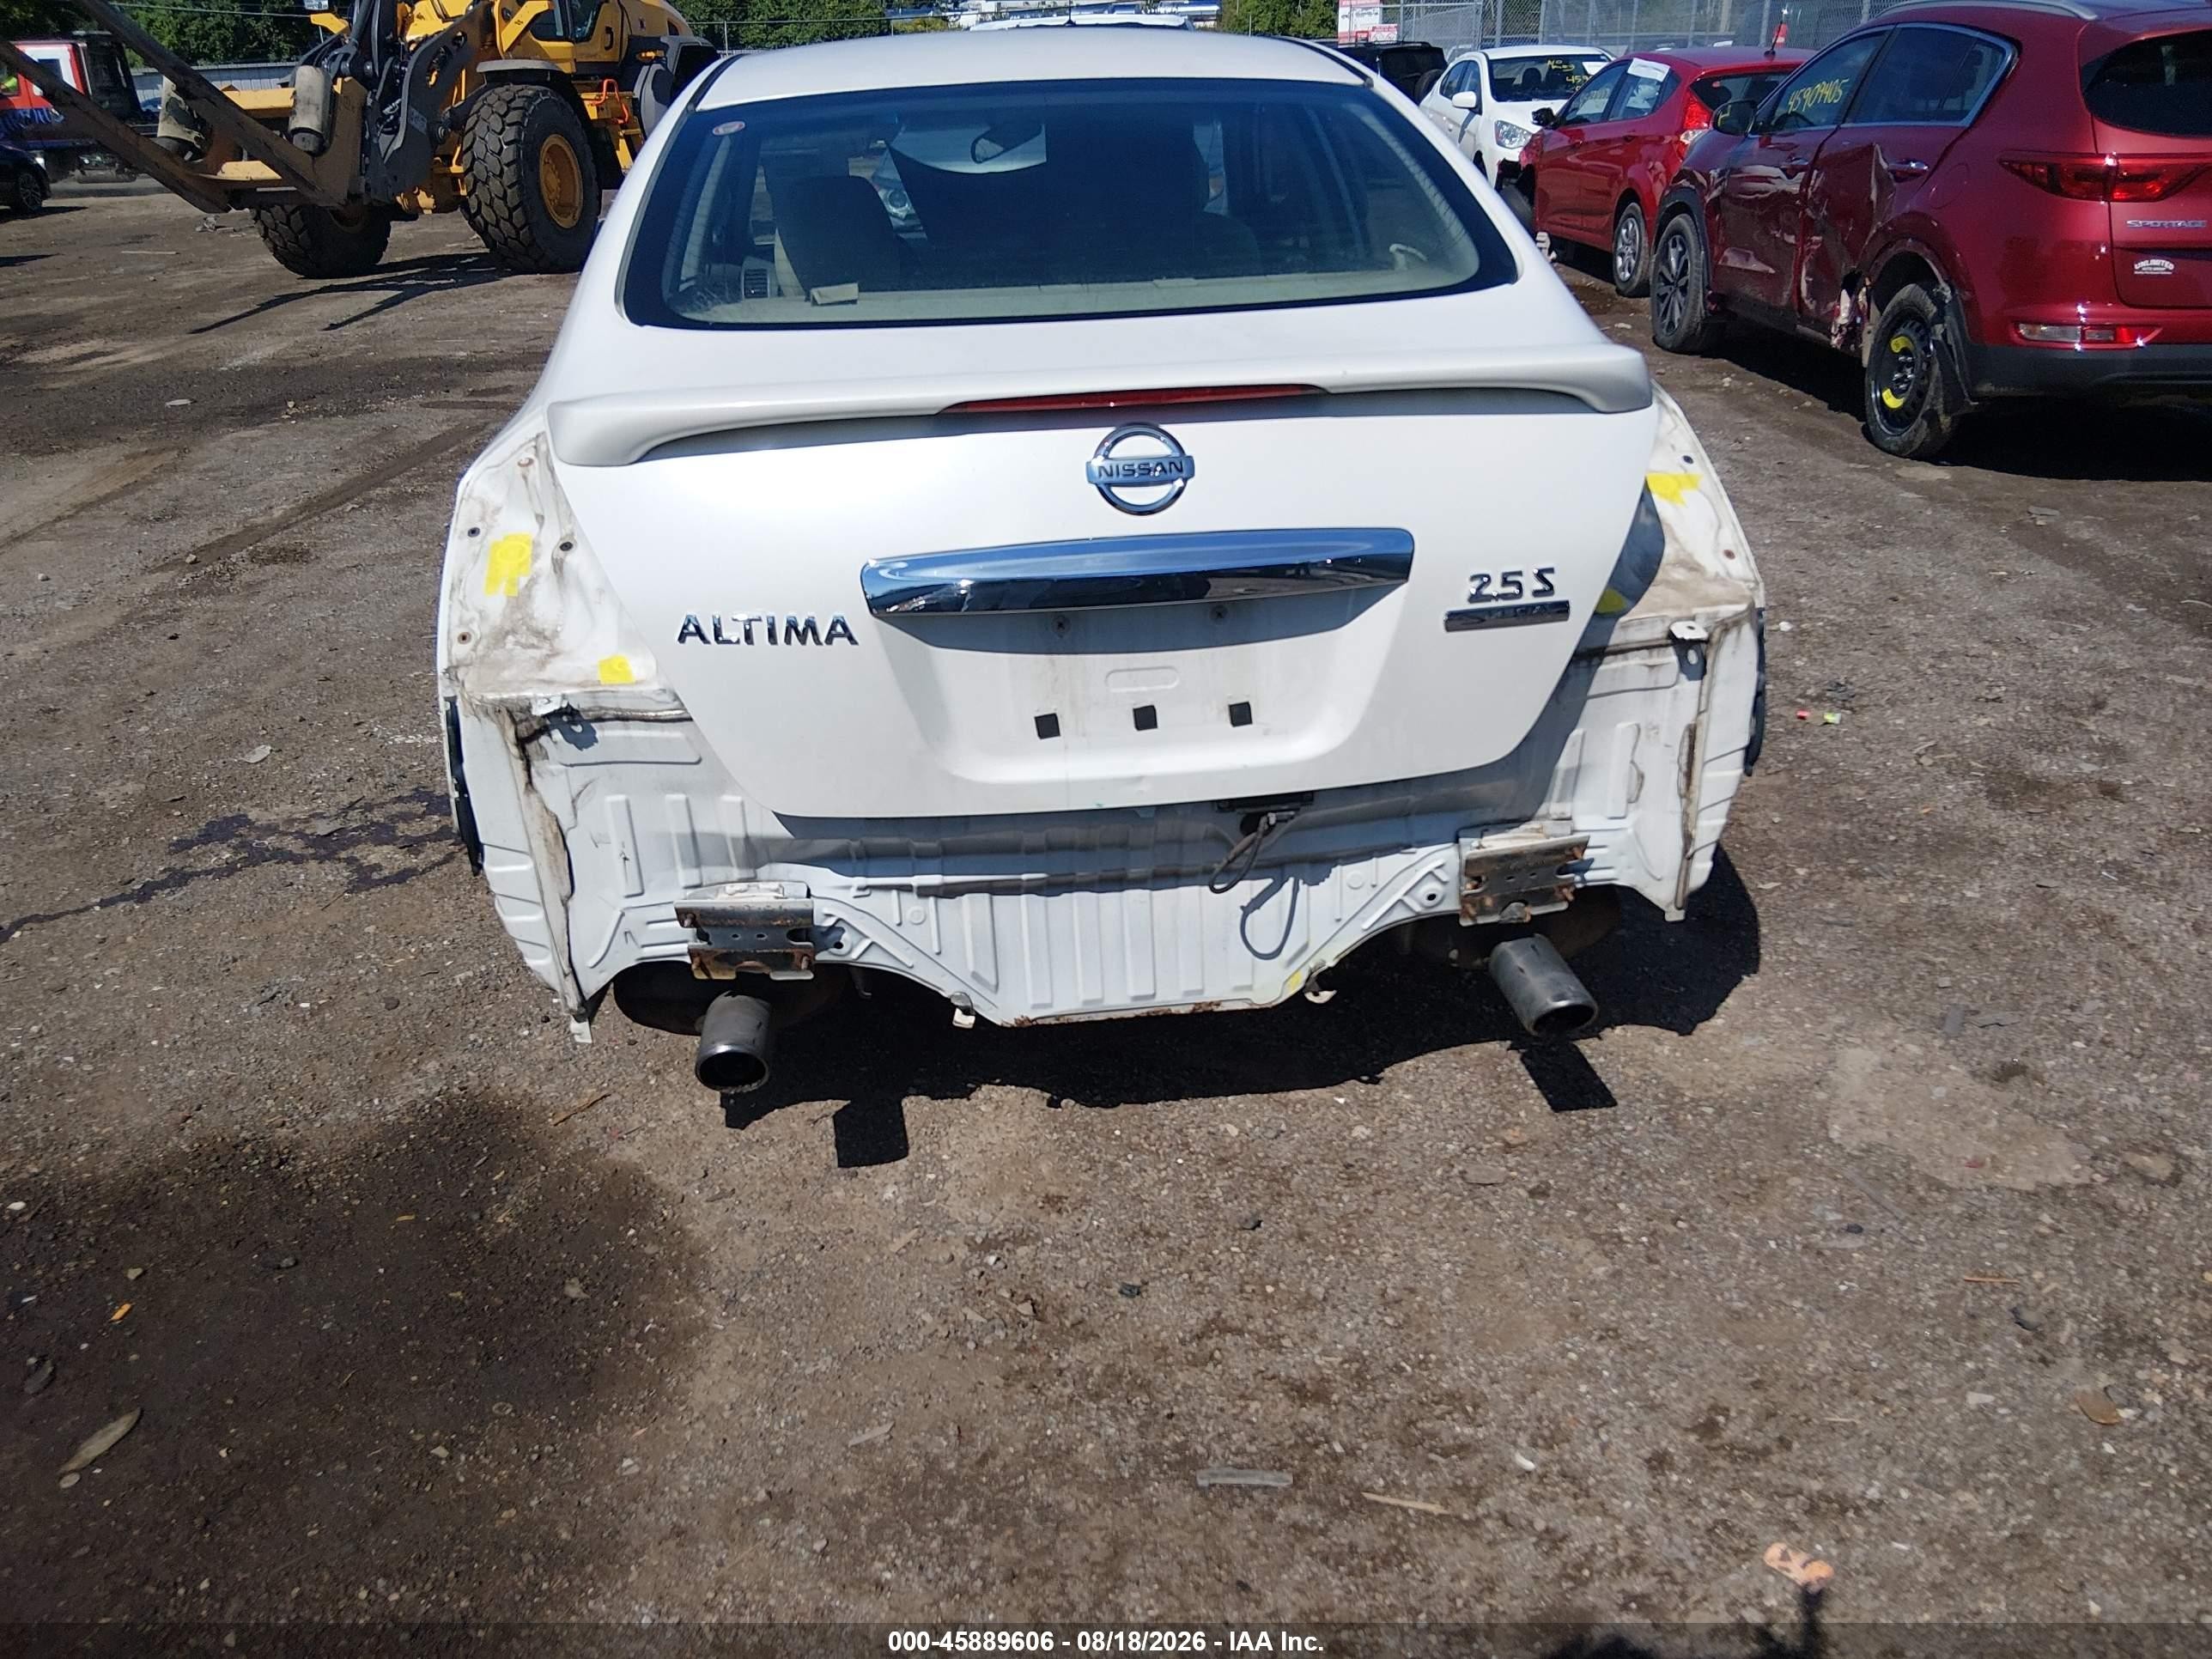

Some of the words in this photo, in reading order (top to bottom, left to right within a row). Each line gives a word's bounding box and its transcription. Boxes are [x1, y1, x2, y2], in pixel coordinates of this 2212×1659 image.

[2126, 220, 2207, 228] SPORTAGE
[1098, 461, 1183, 478] NISSAN
[1532, 568, 1554, 597] S
[678, 614, 859, 646] ALTIMA
